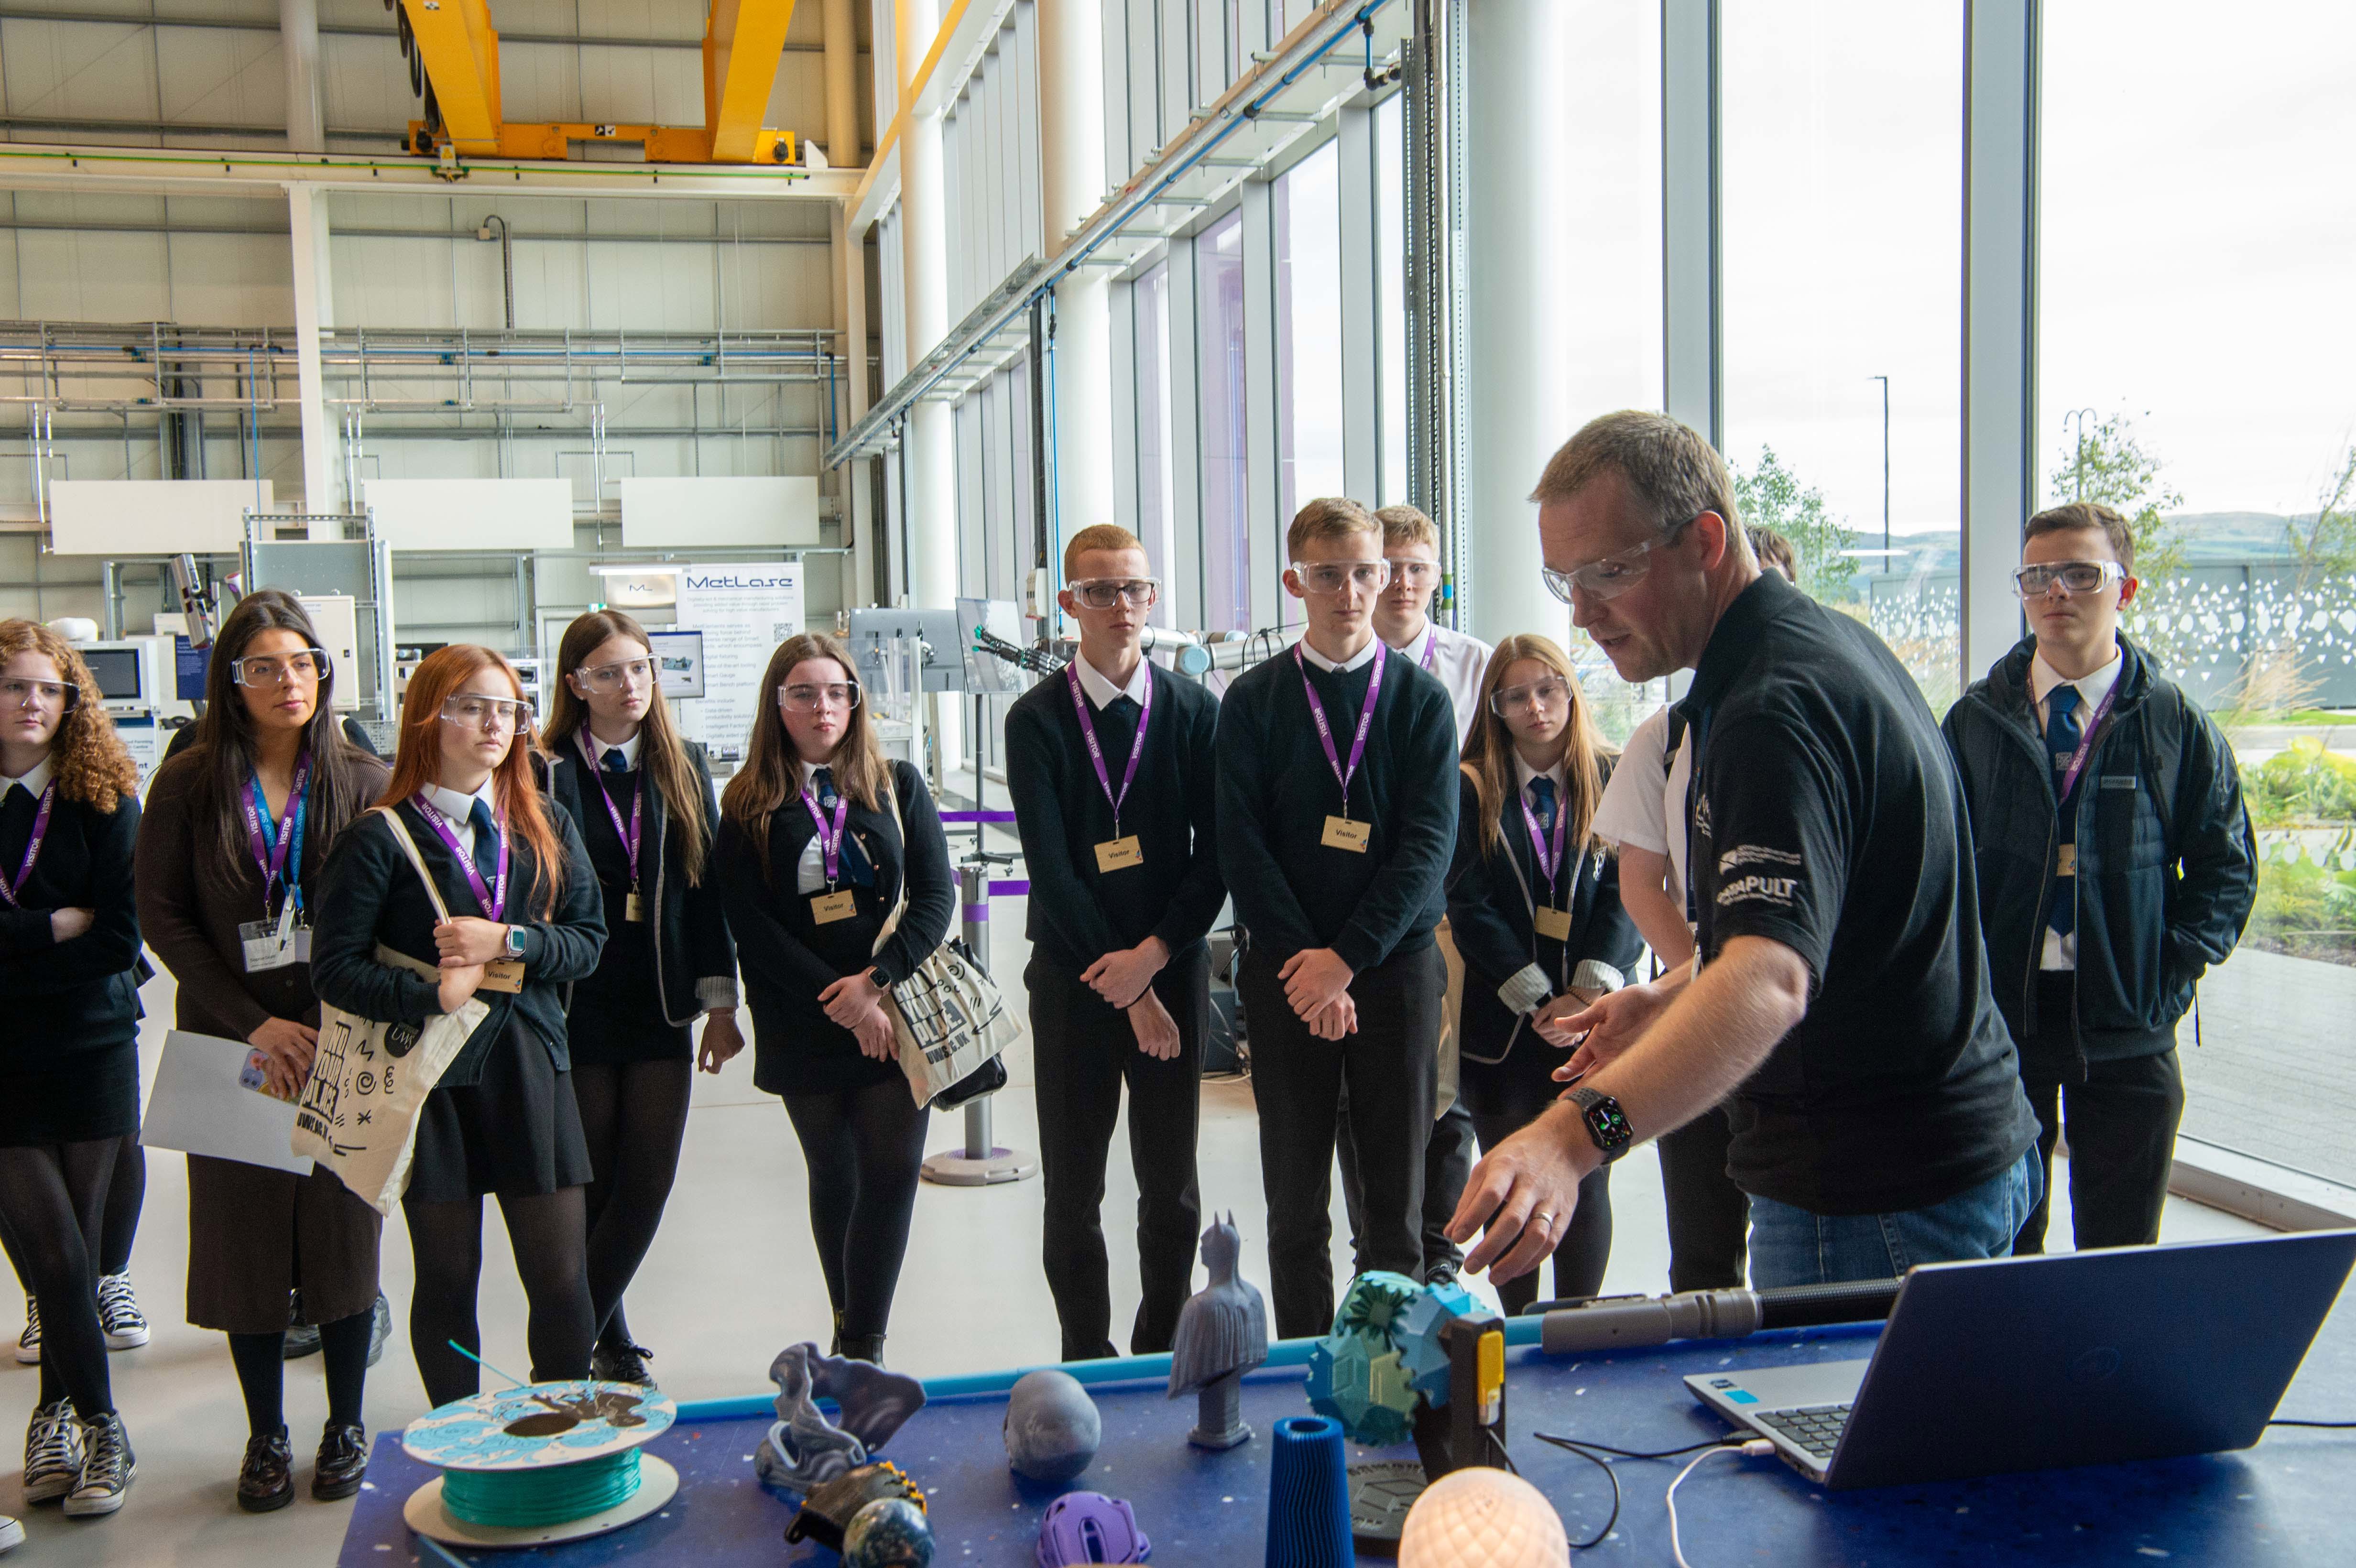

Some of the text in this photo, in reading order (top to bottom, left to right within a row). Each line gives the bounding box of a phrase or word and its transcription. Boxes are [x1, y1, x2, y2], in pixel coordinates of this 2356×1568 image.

[687, 576, 793, 588] MetLase
[1371, 660, 1382, 687] VISITOR
[1071, 679, 1084, 708] VISITOR
[1314, 707, 1328, 738] VISITOR
[1357, 712, 1371, 741] VISITOR
[1086, 729, 1100, 759] VISITOR
[1132, 731, 1143, 759] VISITOR
[292, 768, 306, 795] VISITOR
[42, 786, 54, 814] VISITOR
[807, 797, 821, 819] VISITOR
[247, 806, 259, 835] VISITOR
[259, 808, 275, 848] School Staff
[421, 802, 443, 828] VISITOR
[611, 806, 624, 833] VISITOR
[279, 817, 293, 845] VISITOR
[830, 829, 840, 856] VISITOR
[1335, 828, 1358, 840] Visitor
[25, 838, 41, 867] VISITOR
[455, 846, 475, 876] VISITOR
[1108, 849, 1130, 859] Visitor
[496, 874, 505, 905] VISITOR
[823, 903, 844, 912] Visitor
[488, 971, 512, 980] Visitor
[315, 1051, 344, 1087] OUR
